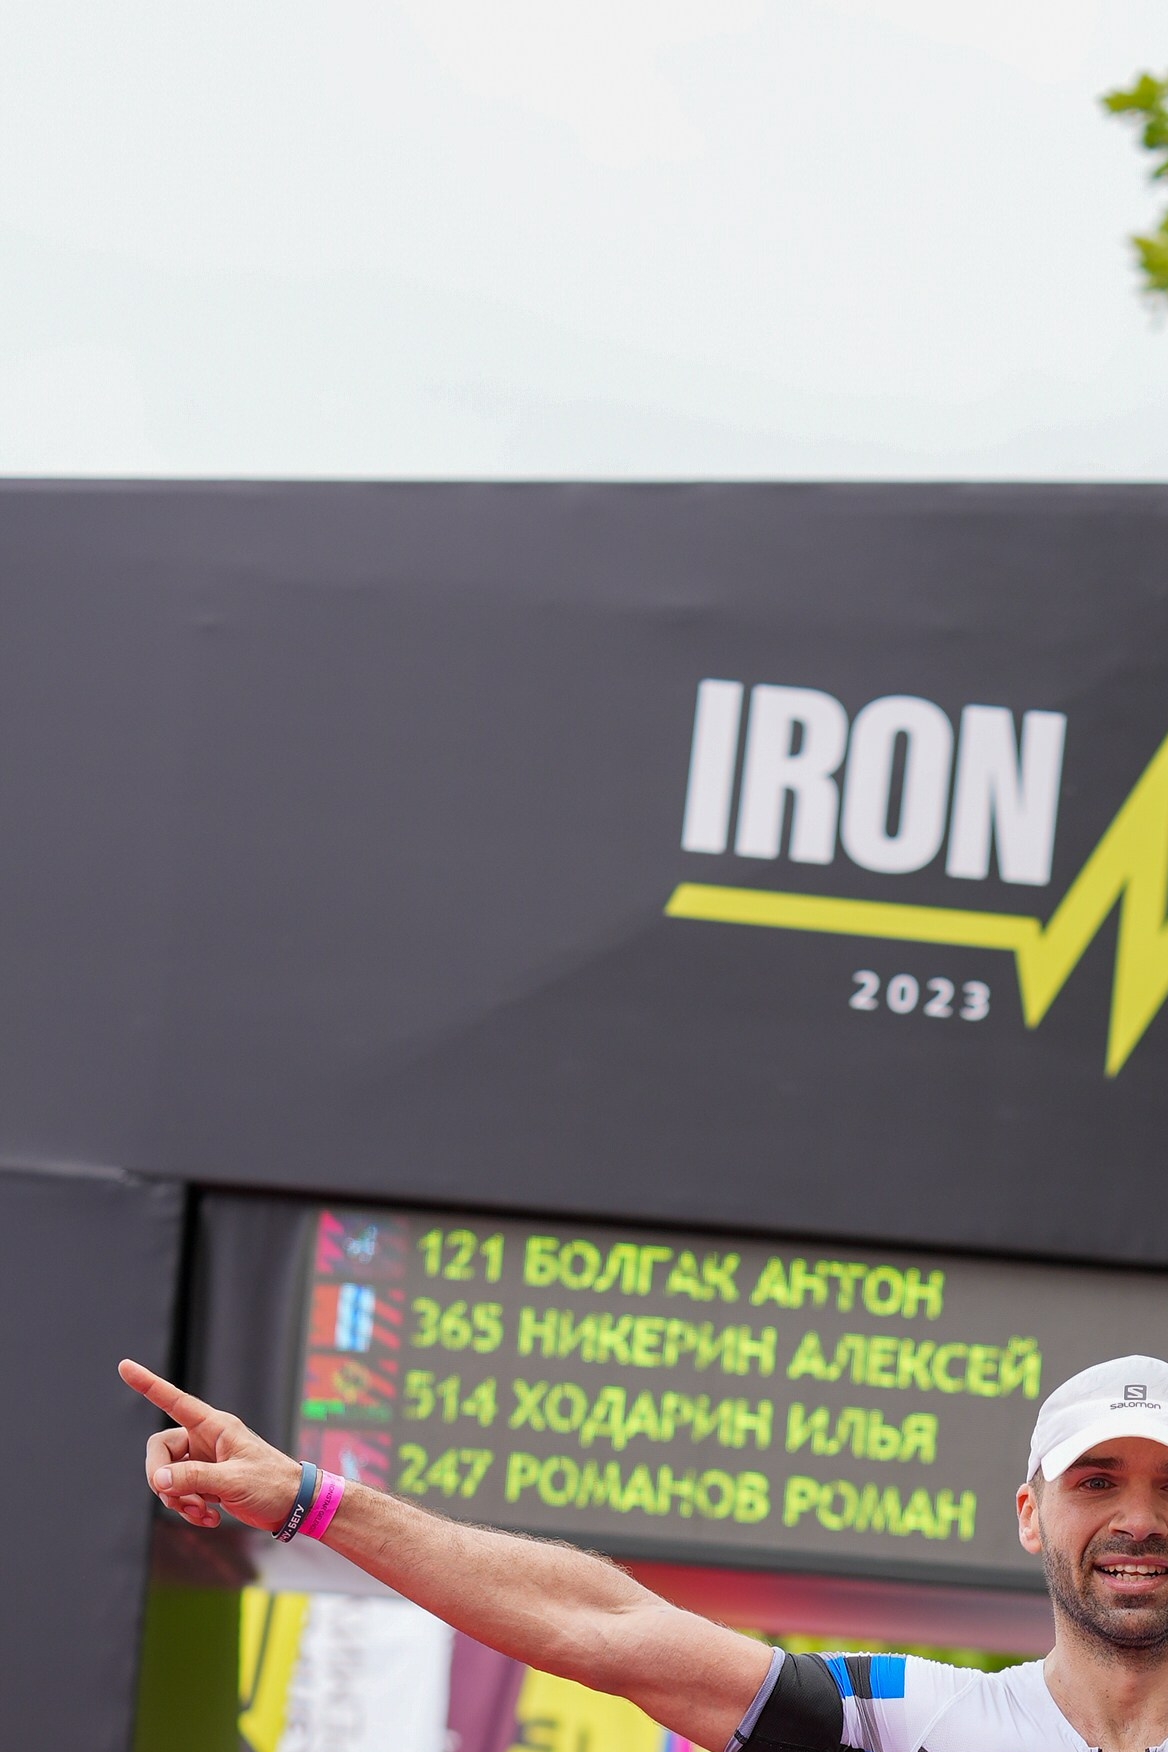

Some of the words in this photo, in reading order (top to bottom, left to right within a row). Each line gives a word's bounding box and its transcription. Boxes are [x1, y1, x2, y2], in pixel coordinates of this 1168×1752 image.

[681, 678, 1067, 886] IRON
[850, 968, 992, 1021] 2023
[419, 1229, 504, 1280] 121
[523, 1235, 740, 1301] БОЛГАК
[751, 1257, 944, 1317] АНТОН
[413, 1297, 503, 1352] 365
[518, 1306, 778, 1374] НИКЕРИН
[787, 1331, 1042, 1398] АЛЕКСЕЙ
[406, 1370, 497, 1425] 514
[510, 1379, 773, 1449] ХОДАРИН
[785, 1403, 938, 1463] ИЛЬЯ
[288, 1503, 305, 1530] БЕГУ
[400, 1443, 493, 1496] 247
[505, 1451, 770, 1522] РОМАНОВ
[783, 1475, 976, 1539] РОМАН
